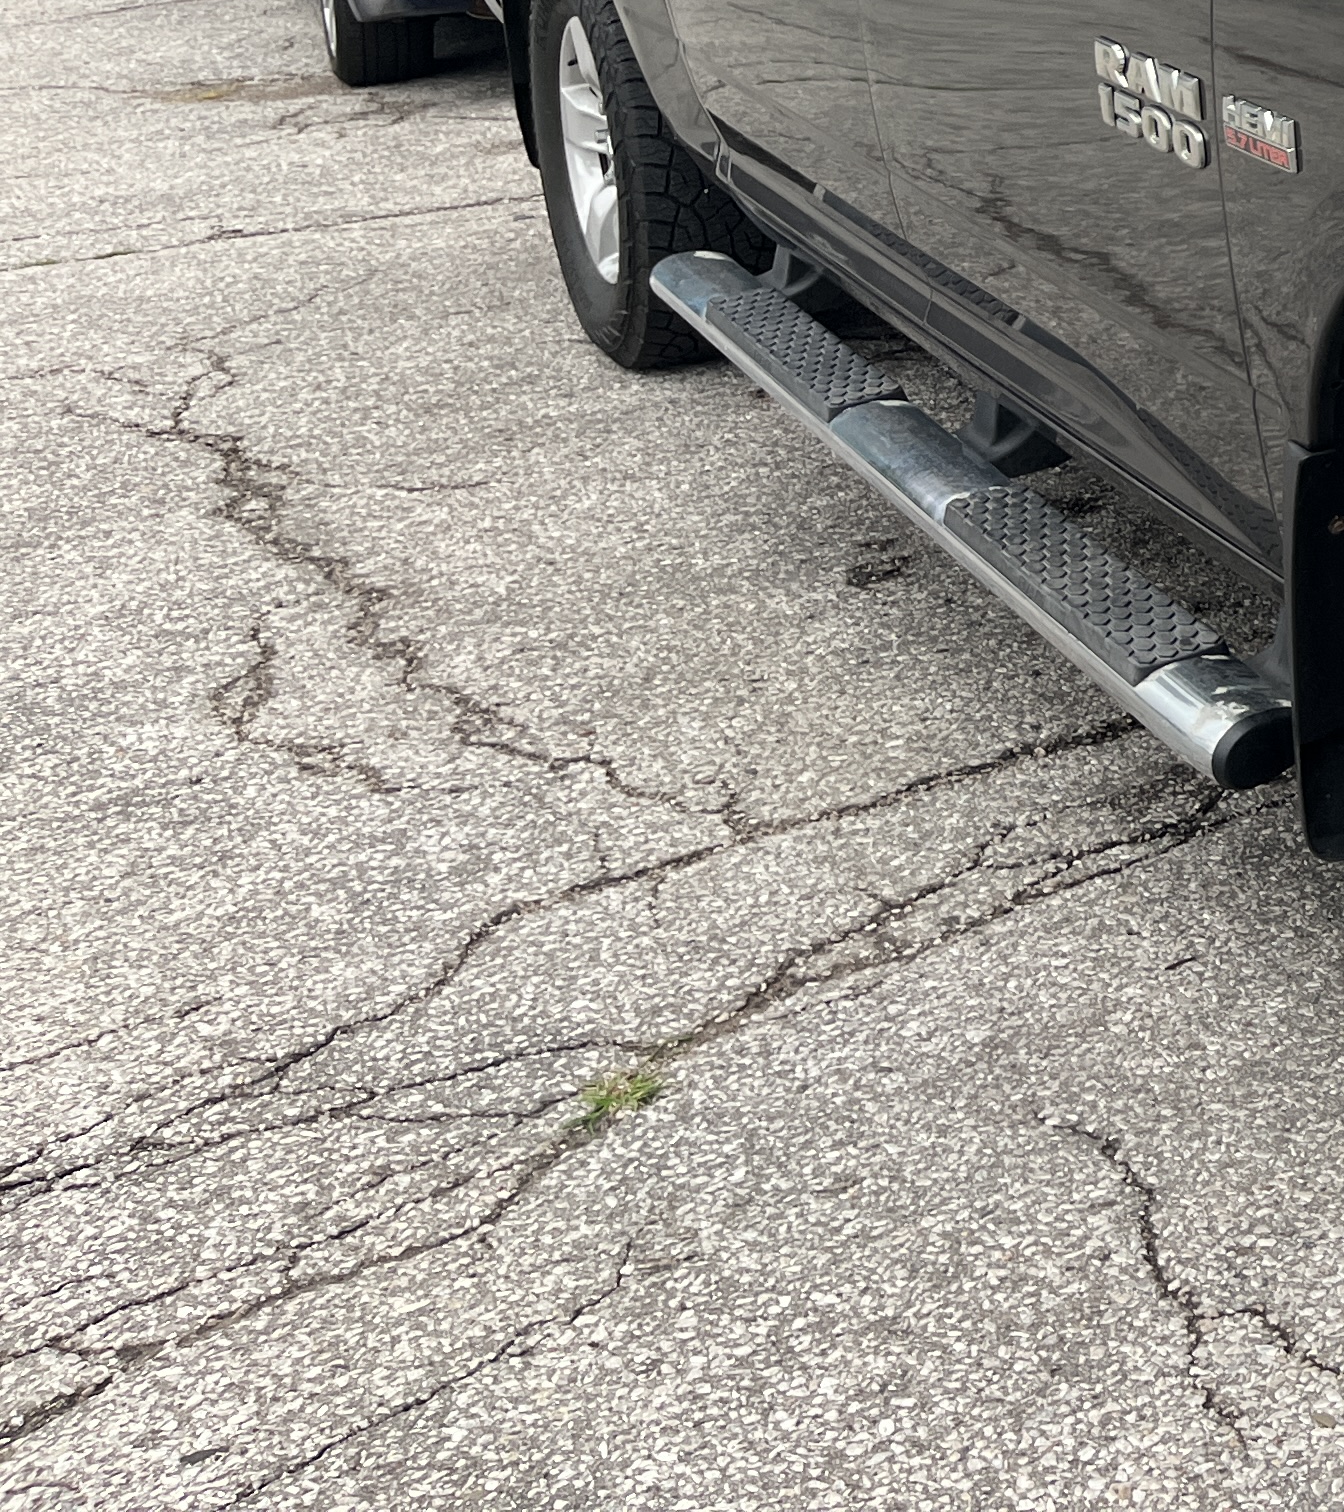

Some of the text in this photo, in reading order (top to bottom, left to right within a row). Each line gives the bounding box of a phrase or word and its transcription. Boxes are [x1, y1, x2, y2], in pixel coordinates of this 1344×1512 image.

[1094, 36, 1205, 120] RAM
[1098, 83, 1211, 169] 1500
[1222, 95, 1295, 150] HEMI
